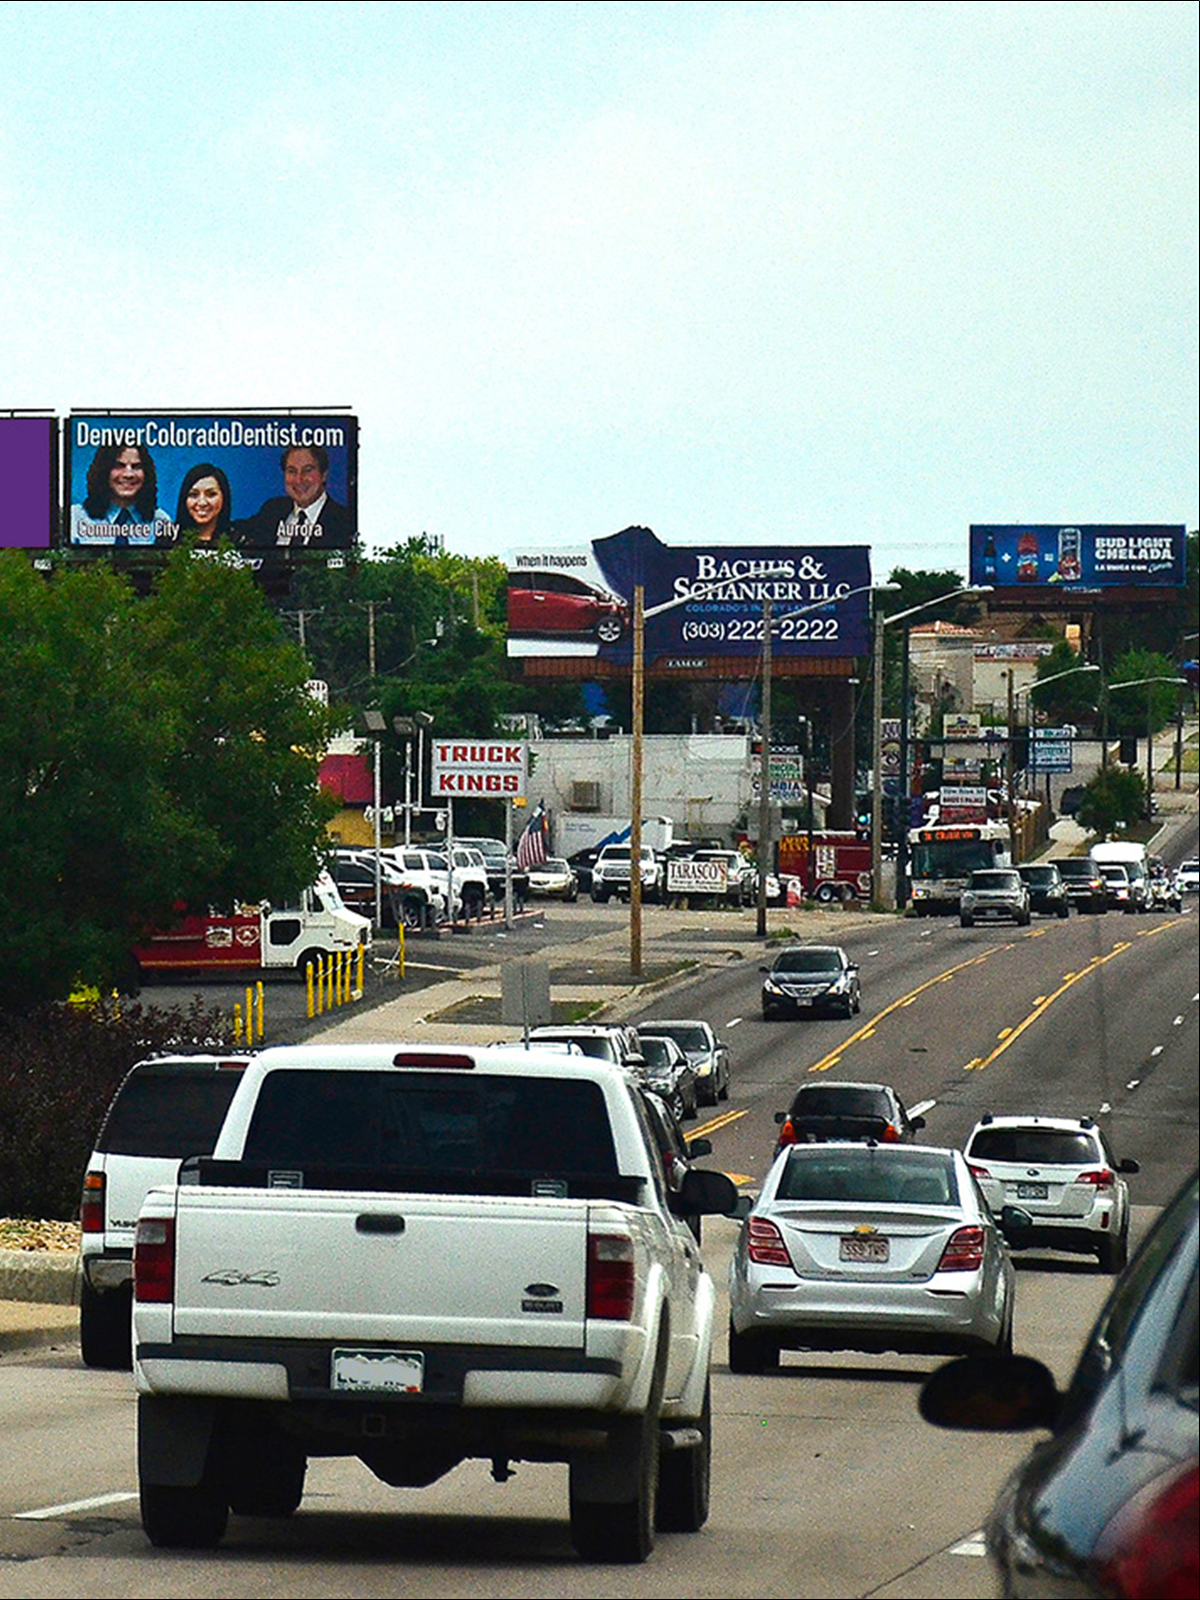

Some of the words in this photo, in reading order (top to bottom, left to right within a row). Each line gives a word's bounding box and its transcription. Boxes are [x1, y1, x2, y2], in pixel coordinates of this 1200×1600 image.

[76, 421, 344, 447] DenverColoradoDentist.com
[77, 519, 151, 538] Commerce
[154, 519, 180, 541] City
[276, 521, 323, 537] Aurora
[1095, 537, 1127, 549] BUD
[1128, 537, 1173, 549] LIGHT
[516, 554, 541, 567] When
[549, 555, 588, 568] happens
[1094, 548, 1175, 560] CHELADA
[798, 555, 828, 581] &
[673, 577, 803, 602] SCHANKER
[682, 621, 726, 641] (303)
[727, 618, 839, 641] 222-2222
[436, 744, 521, 763] TRUCK
[440, 774, 519, 792] KINGS
